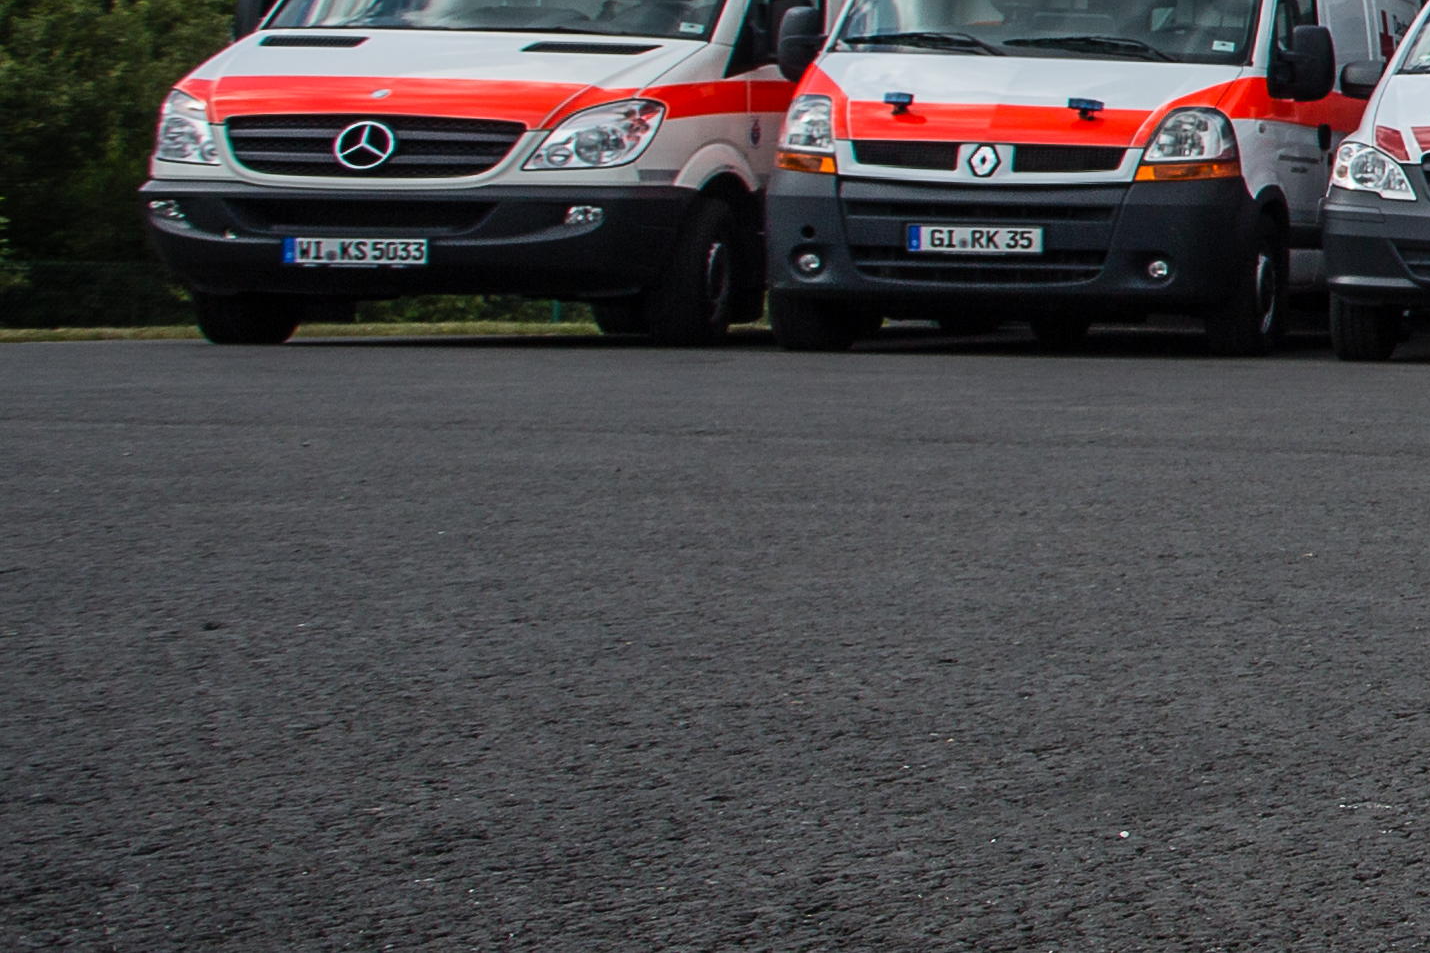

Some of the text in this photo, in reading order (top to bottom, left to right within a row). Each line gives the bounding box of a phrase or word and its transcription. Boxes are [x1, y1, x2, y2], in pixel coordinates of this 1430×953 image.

[930, 229, 1033, 249] GI RK 35
[299, 241, 425, 261] WI KS 5033
